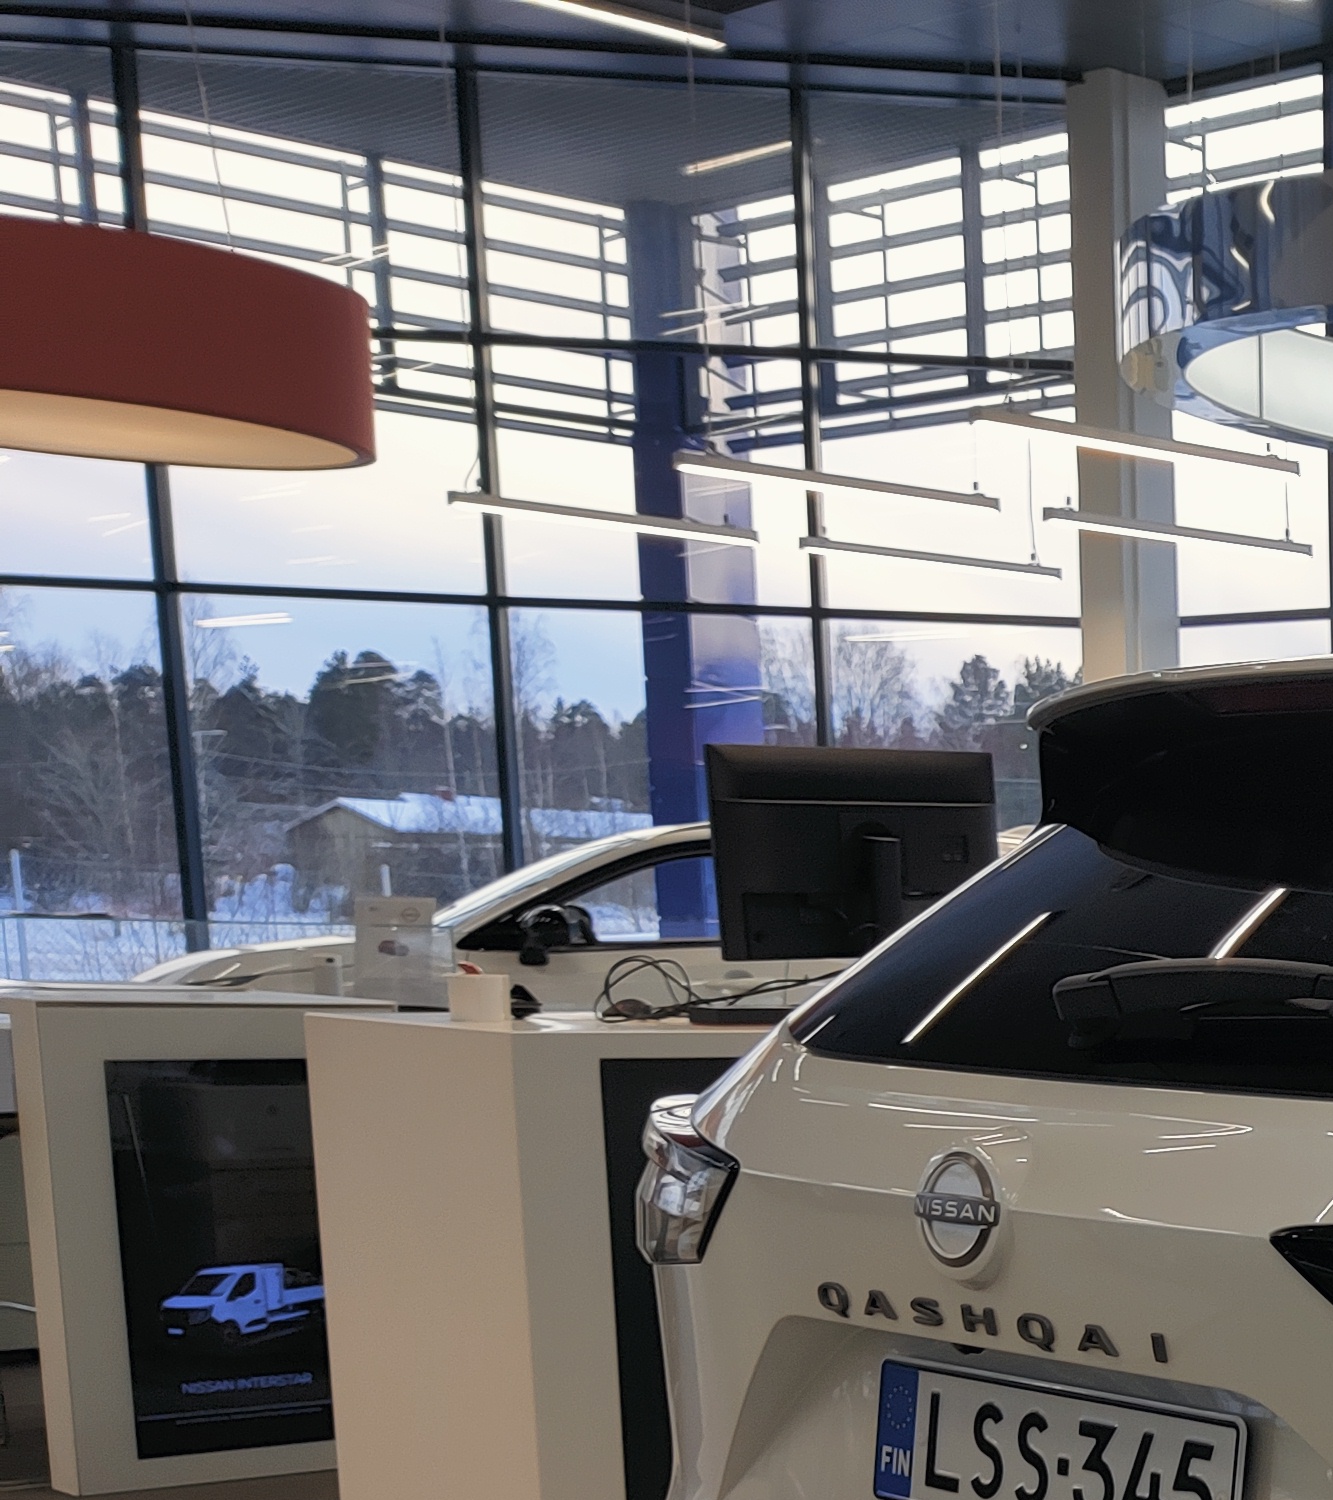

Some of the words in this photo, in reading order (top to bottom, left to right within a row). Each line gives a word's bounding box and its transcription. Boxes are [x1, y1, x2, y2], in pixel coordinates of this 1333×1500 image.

[914, 1196, 997, 1225] NISSAN
[816, 1281, 1169, 1364] QASHQAI
[181, 1379, 236, 1394] NISSAN
[880, 1444, 911, 1478] FIN
